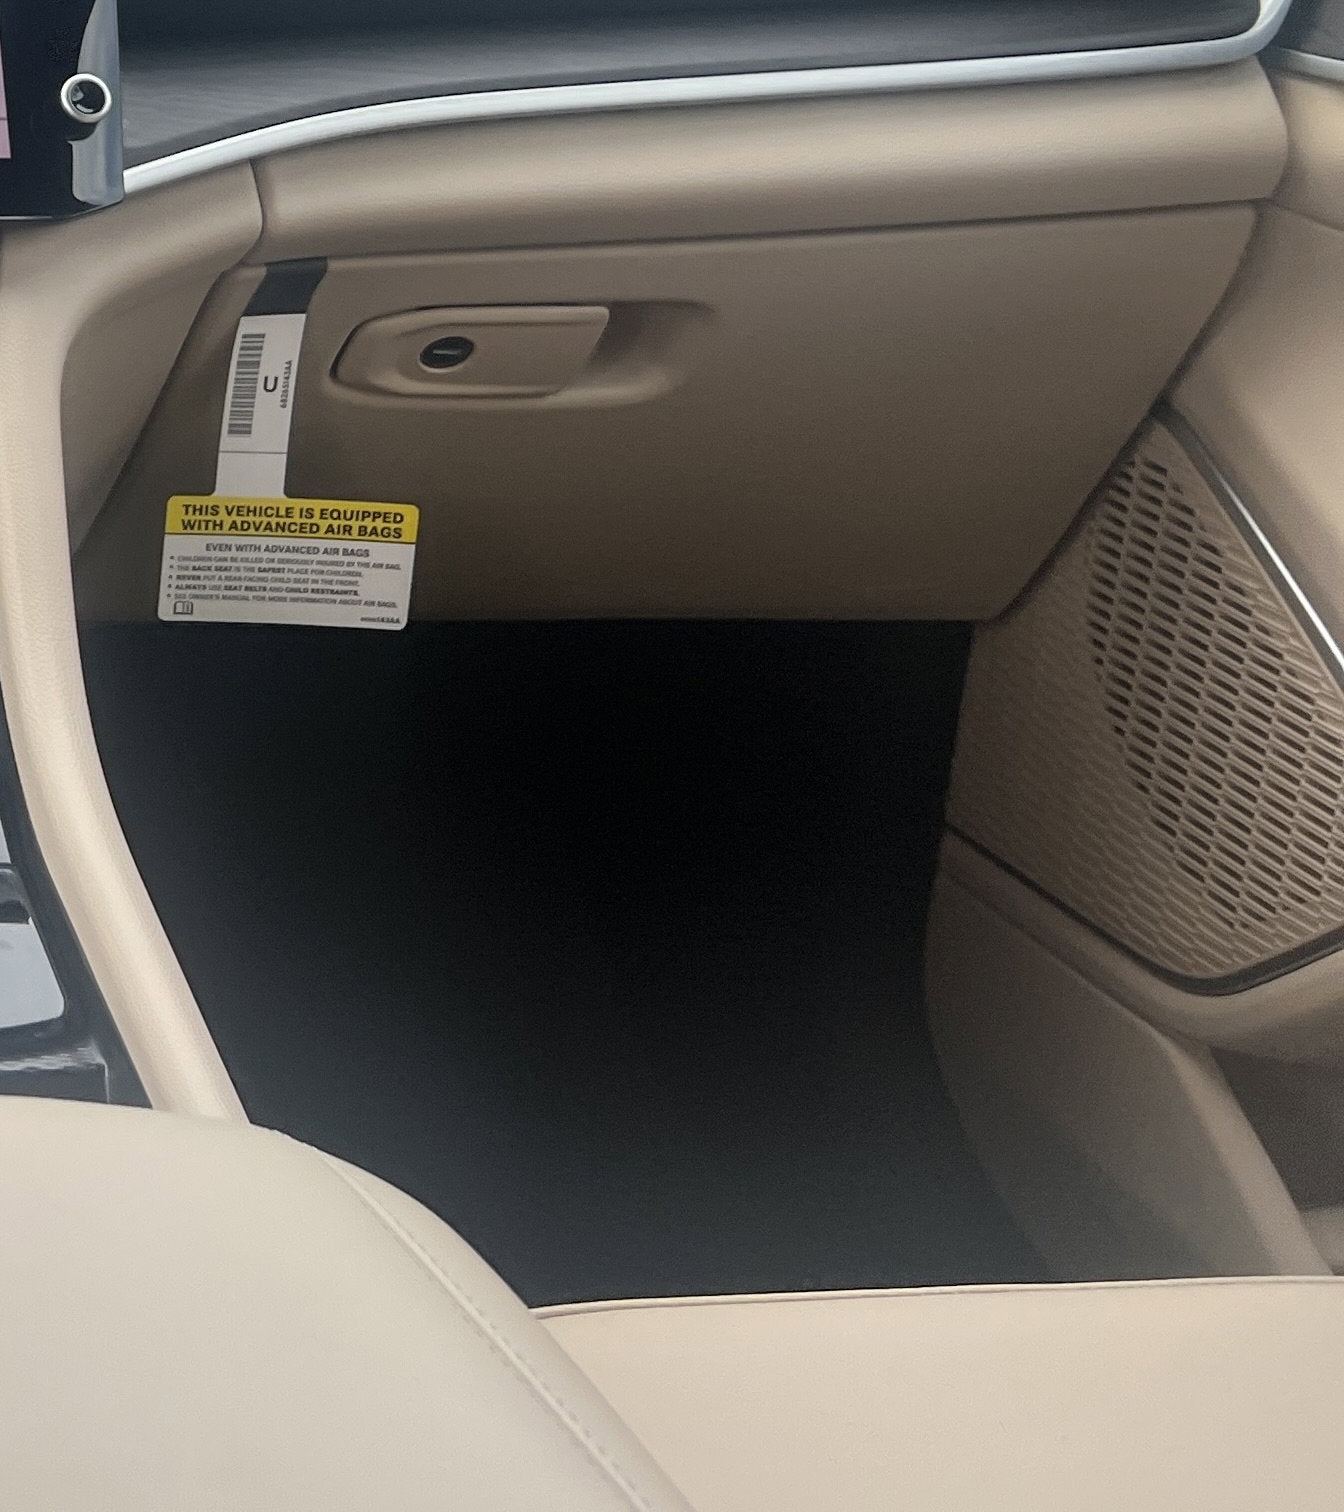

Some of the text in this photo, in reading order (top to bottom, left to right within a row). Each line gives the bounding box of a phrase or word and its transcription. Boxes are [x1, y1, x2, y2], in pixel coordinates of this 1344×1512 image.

[263, 375, 279, 393] U
[182, 503, 405, 524] THIS VEHICLE IS EQUIPPED
[181, 518, 403, 539] WITH ADVANCED AIR BAGS
[205, 543, 370, 558] EVEN WITH ADVANCED AIR BAGS
